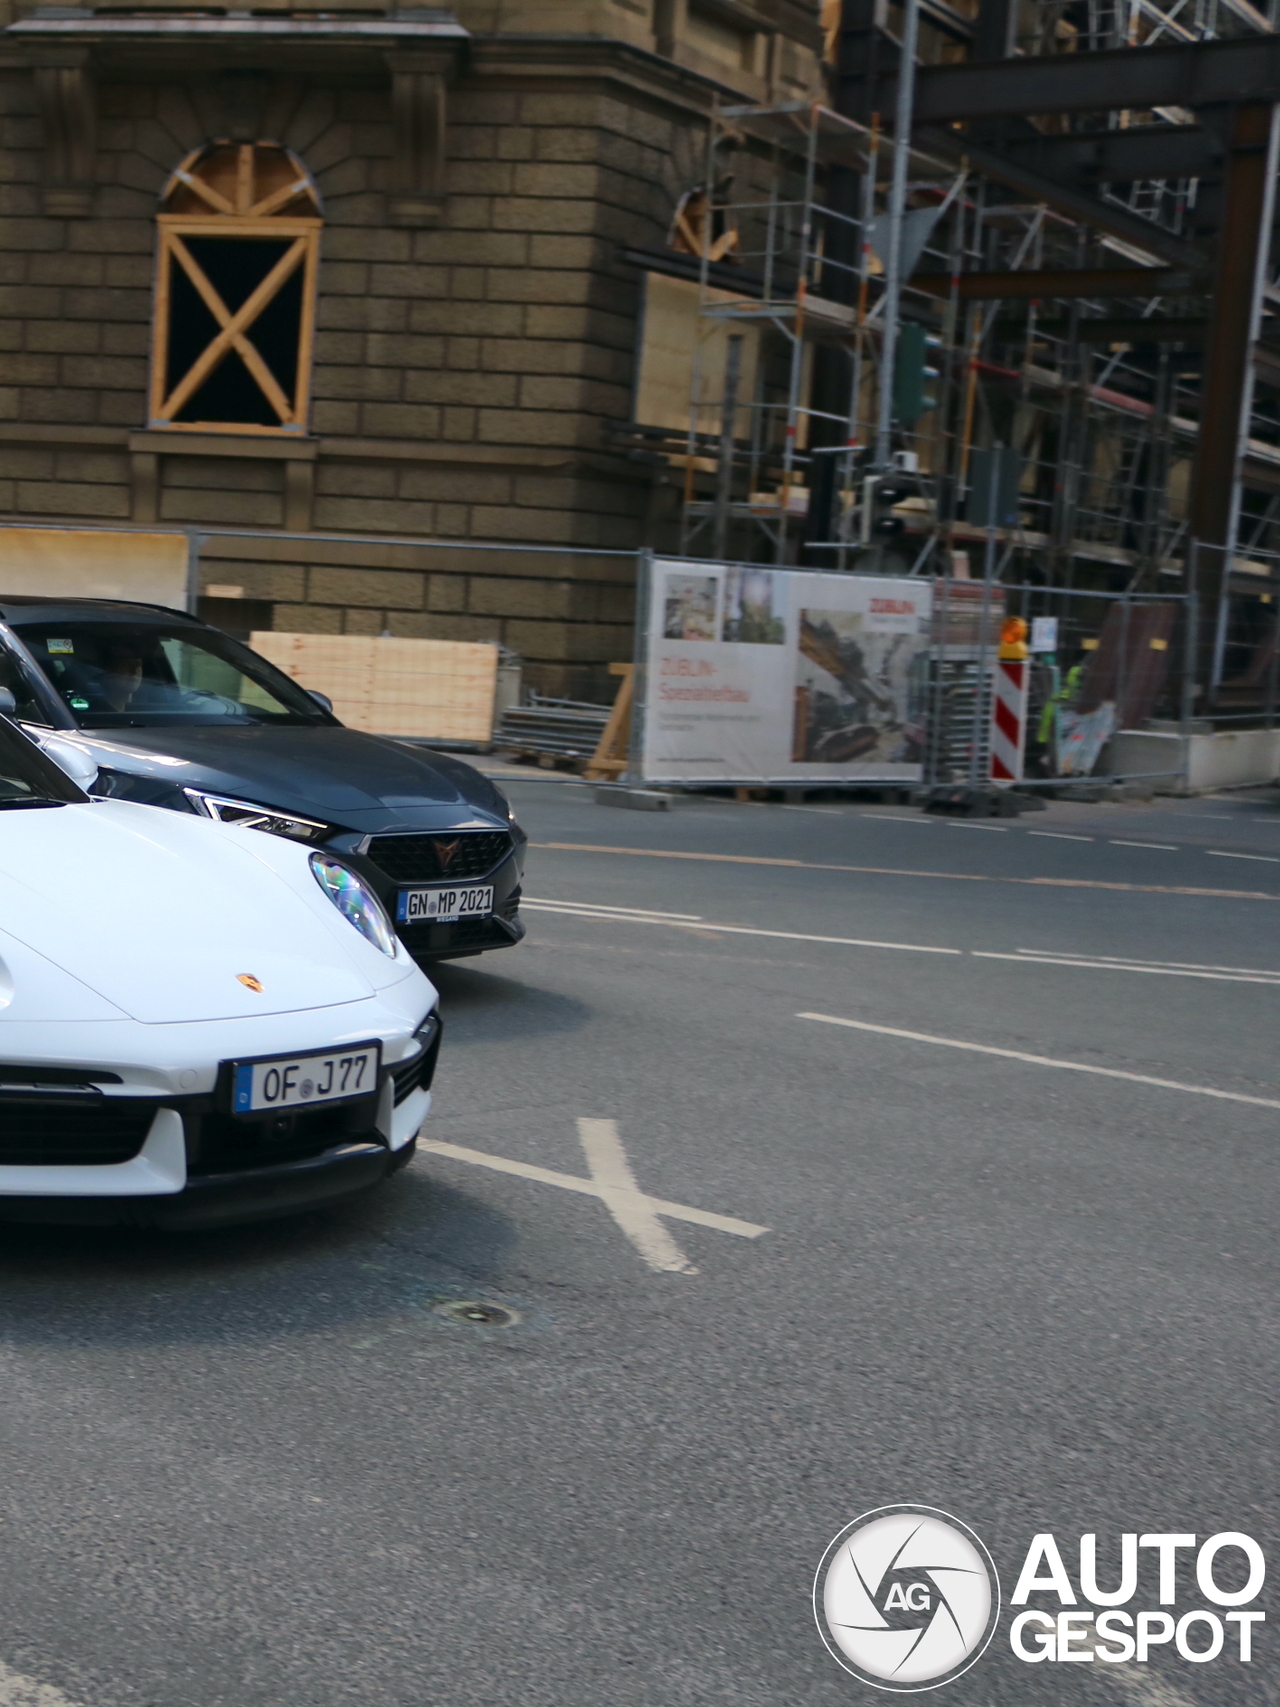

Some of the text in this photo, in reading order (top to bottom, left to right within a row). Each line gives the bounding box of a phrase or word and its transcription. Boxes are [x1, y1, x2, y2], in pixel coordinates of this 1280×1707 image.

[408, 893, 428, 915] GN
[437, 891, 456, 914] MP
[459, 888, 492, 912] 2021
[263, 1065, 300, 1102] OF
[317, 1055, 368, 1095] J77
